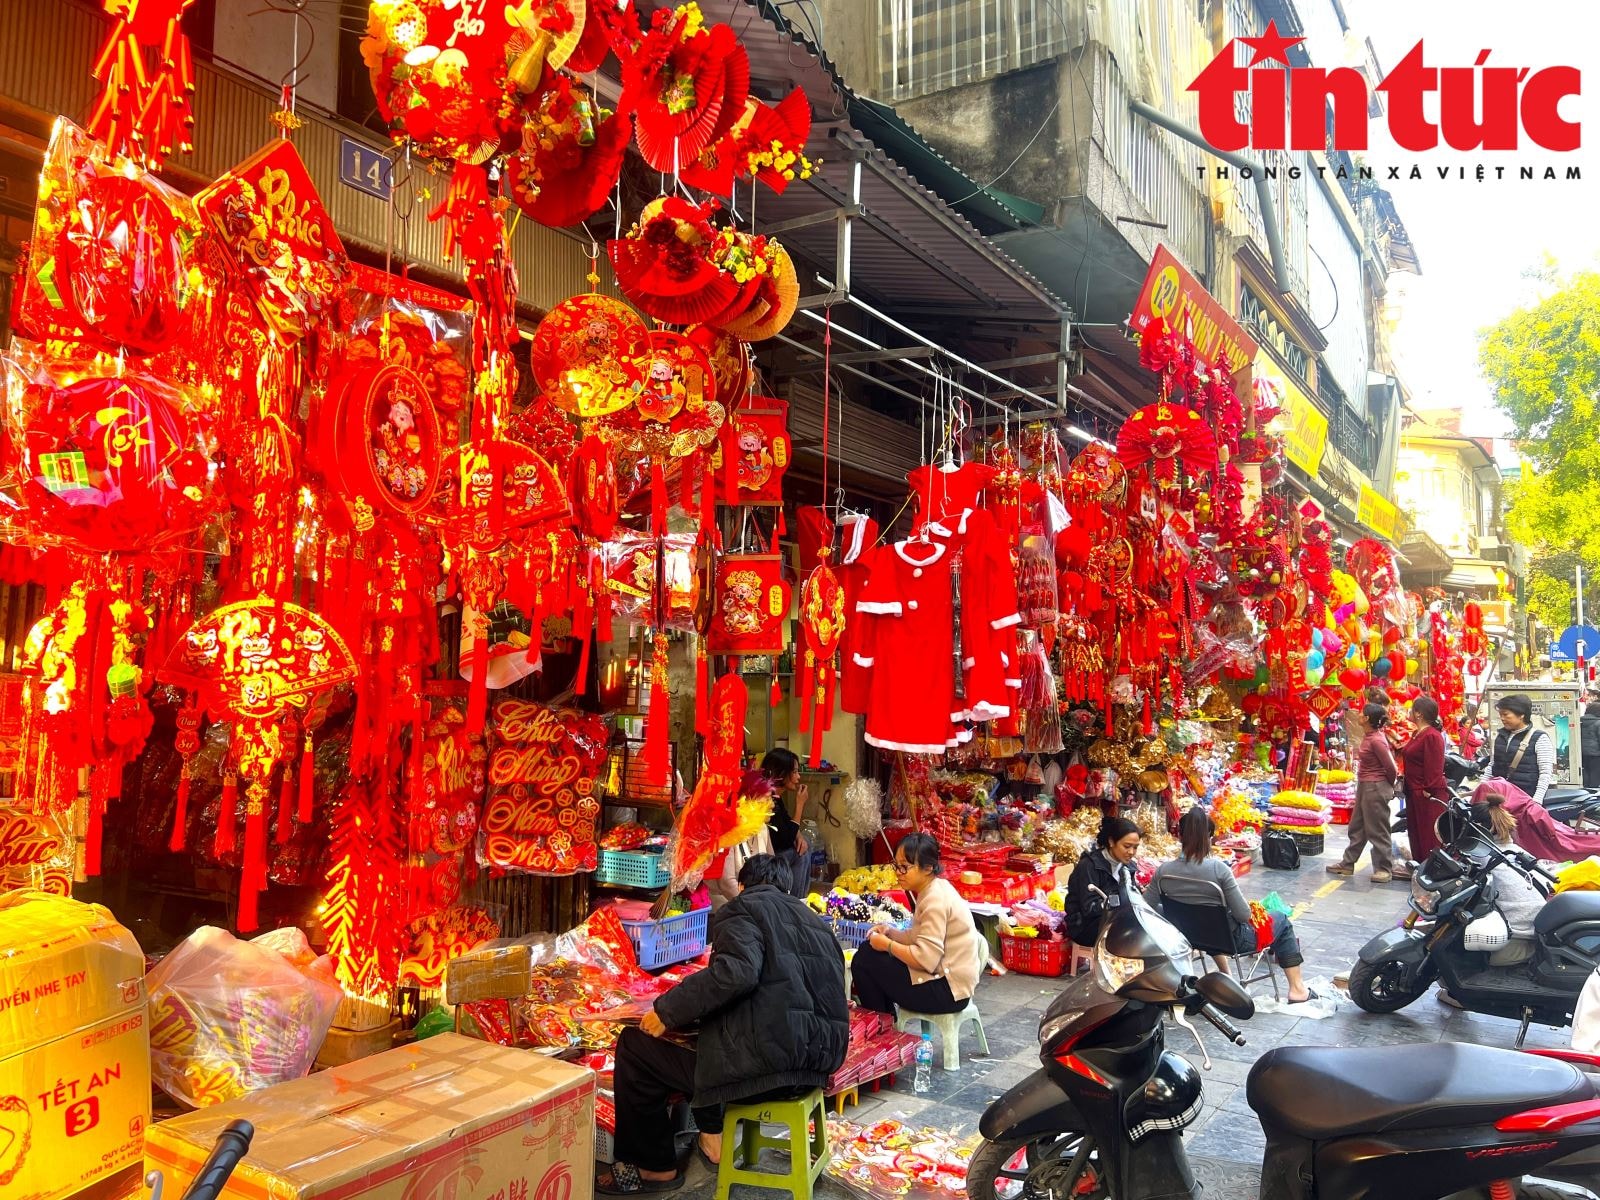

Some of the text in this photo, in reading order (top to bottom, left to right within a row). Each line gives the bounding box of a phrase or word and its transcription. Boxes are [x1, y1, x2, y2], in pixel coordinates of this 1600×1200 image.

[352, 150, 382, 190] 14
[258, 166, 323, 248] Phúc
[498, 701, 565, 742] Chúc
[34, 980, 61, 999] NHẸ
[64, 970, 87, 989] TAY
[38, 1062, 121, 1112] TẾT AN
[73, 1102, 92, 1133] 3
[756, 1110, 772, 1121] 14
